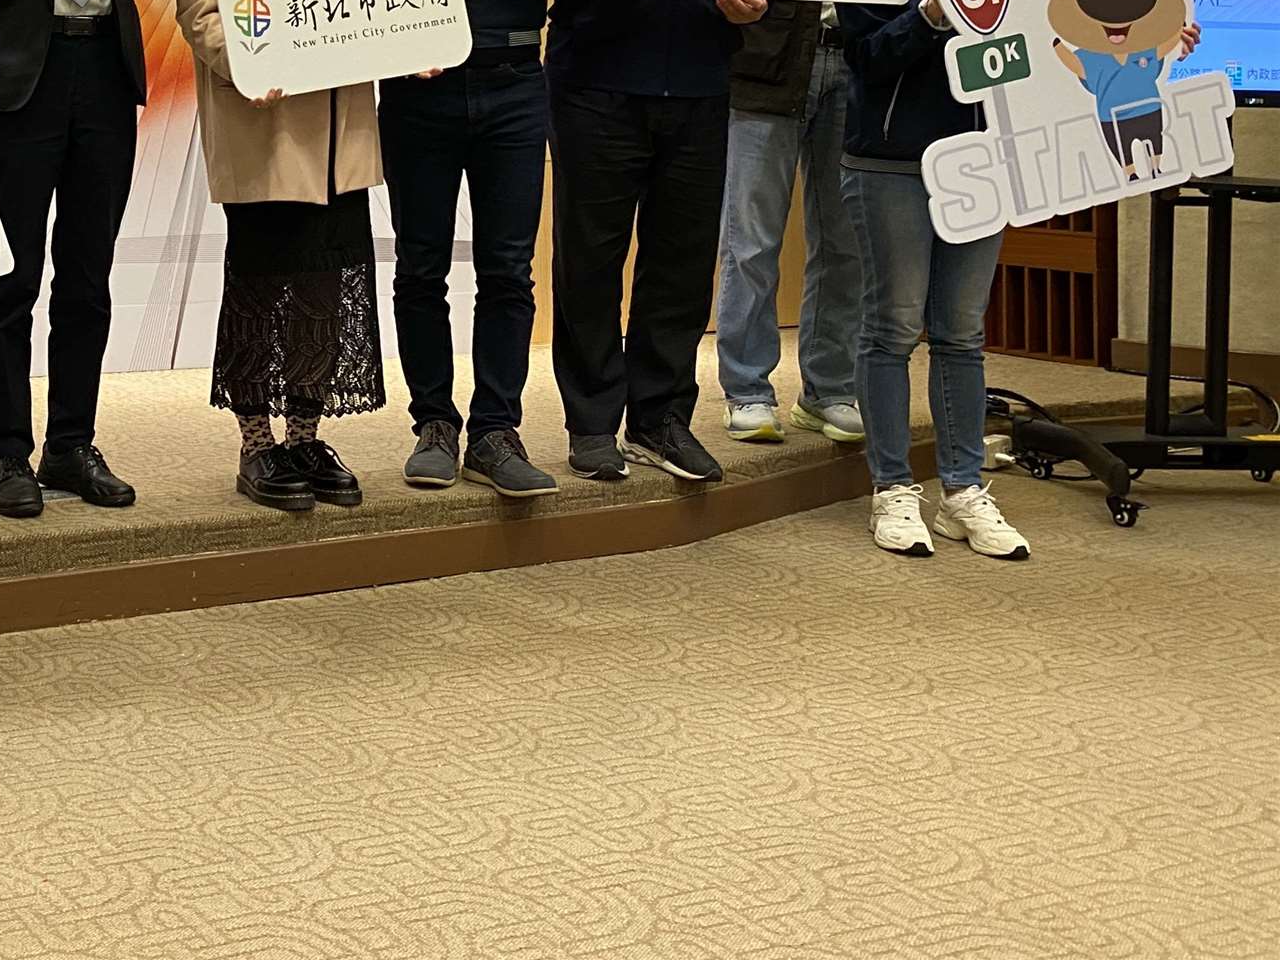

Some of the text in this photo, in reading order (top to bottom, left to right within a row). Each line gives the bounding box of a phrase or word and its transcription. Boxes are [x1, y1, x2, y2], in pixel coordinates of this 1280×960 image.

[291, 14, 458, 50] New Taipei City Government
[932, 81, 1226, 233] START
